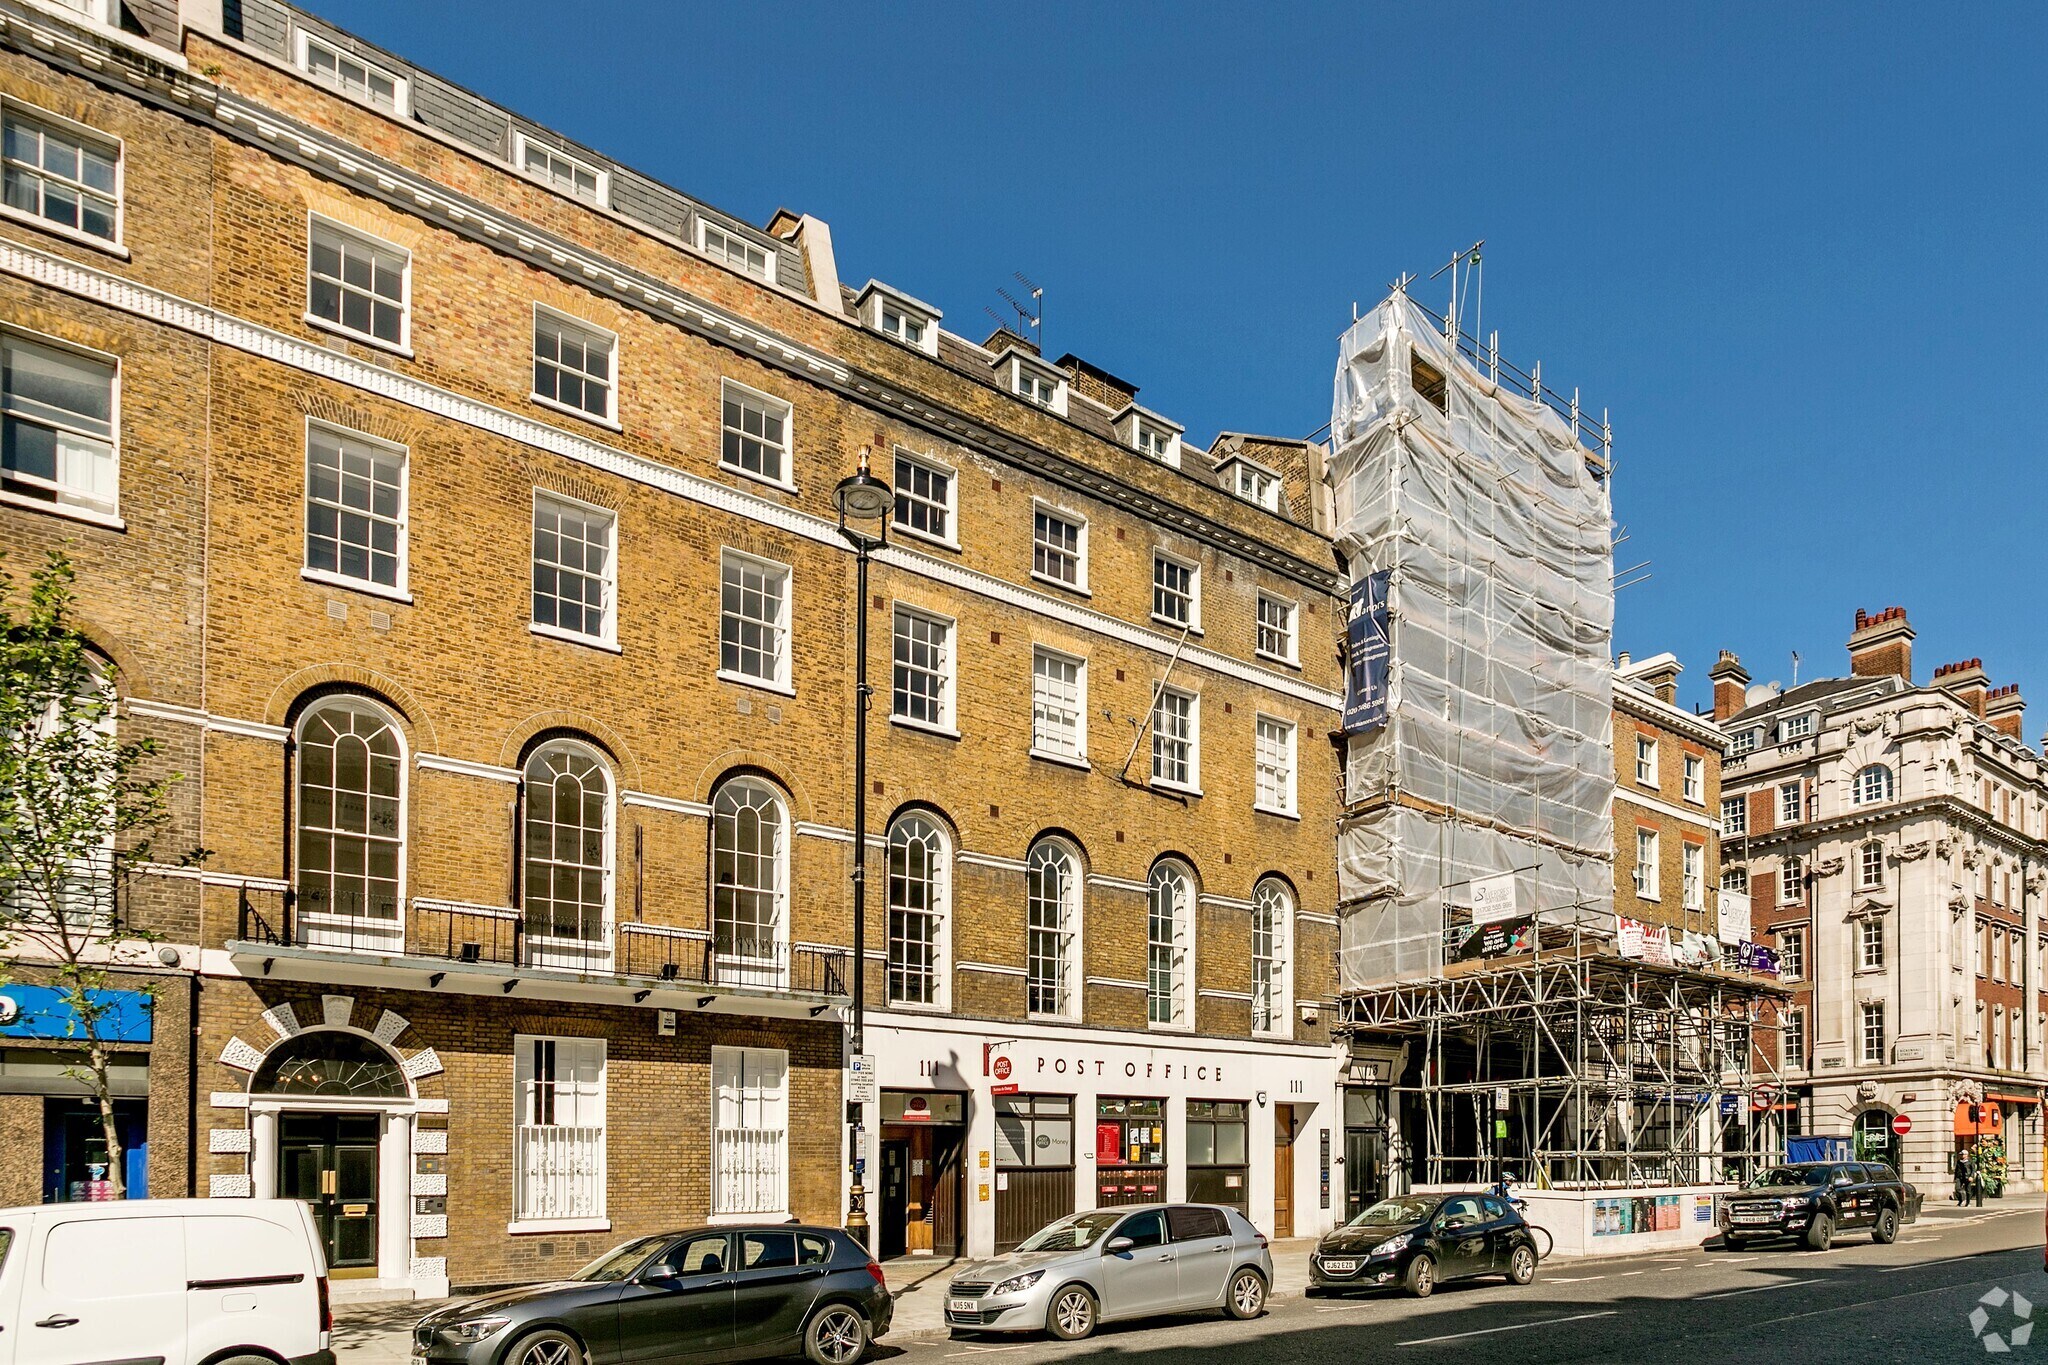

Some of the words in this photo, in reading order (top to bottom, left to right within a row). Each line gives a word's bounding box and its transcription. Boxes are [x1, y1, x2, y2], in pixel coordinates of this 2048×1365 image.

[920, 1060, 939, 1076] 111
[997, 1060, 1009, 1068] POST
[1037, 1057, 1105, 1076] POST
[1125, 1062, 1222, 1081] OFFICE
[995, 1067, 1010, 1075] OFFICE
[1290, 1080, 1303, 1093] 111
[1051, 1138, 1068, 1147] Money
